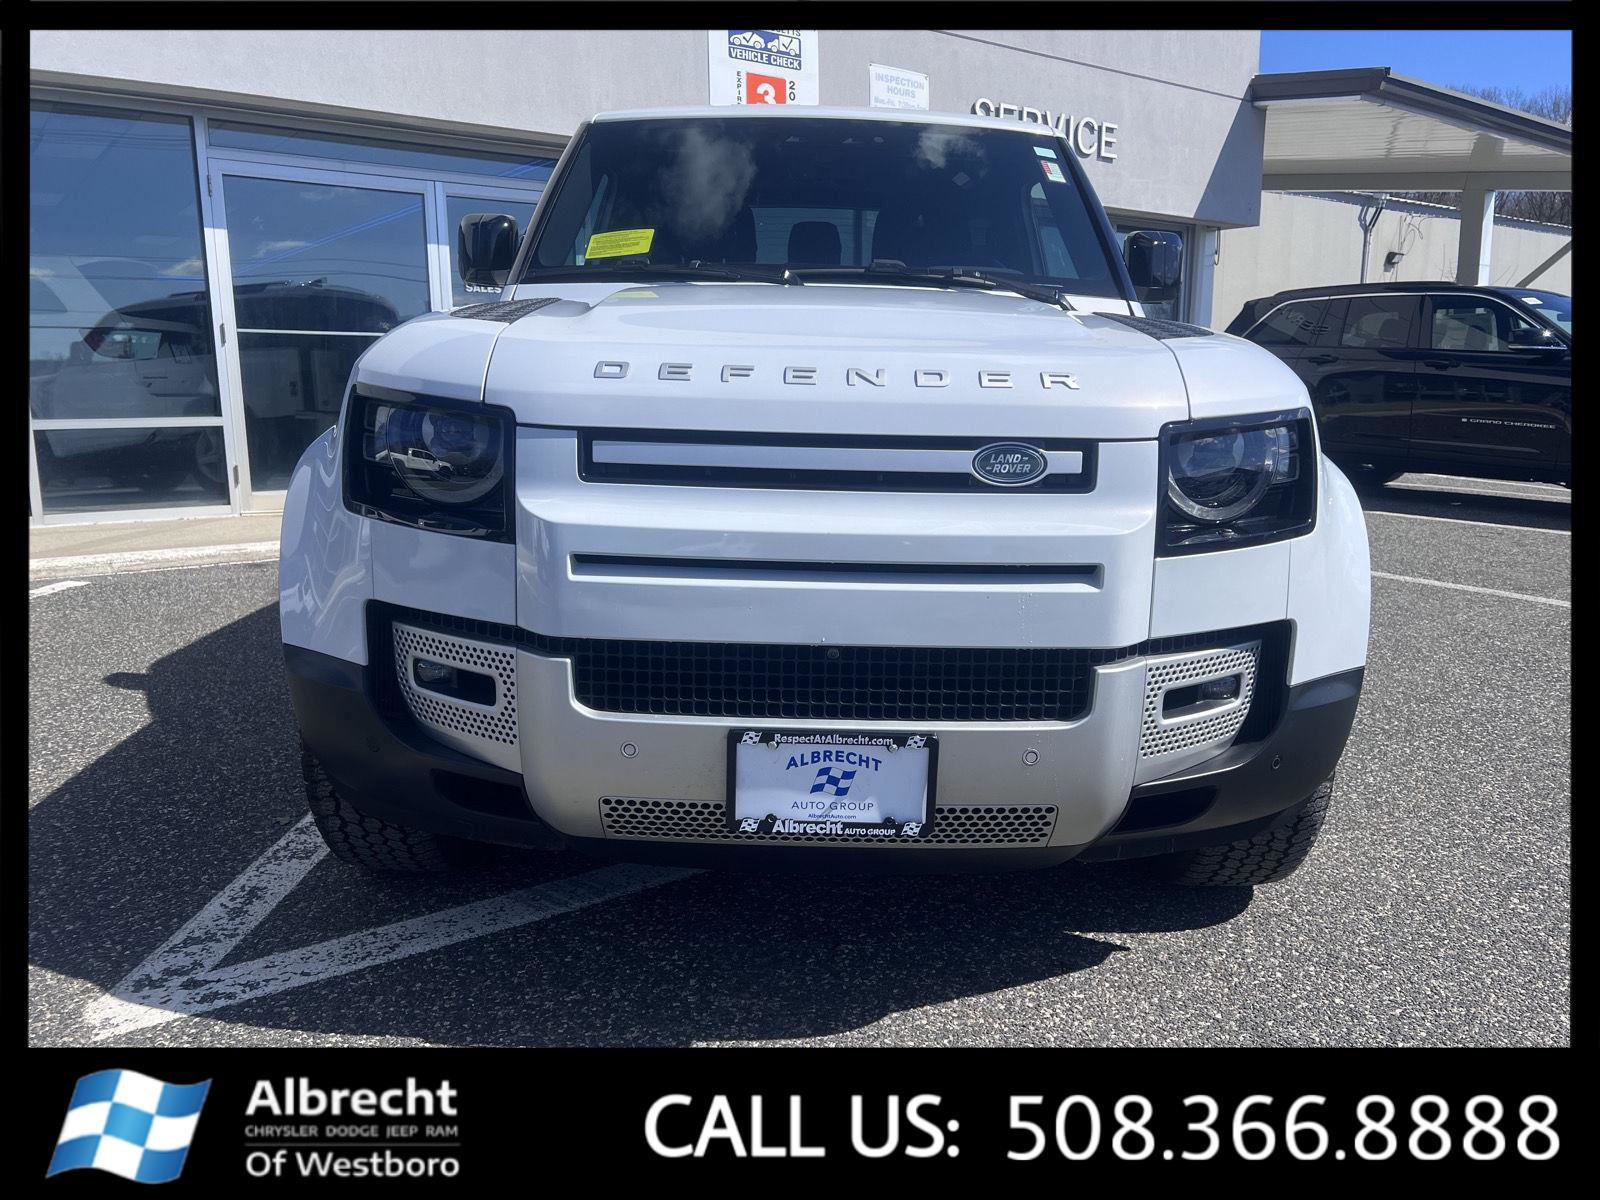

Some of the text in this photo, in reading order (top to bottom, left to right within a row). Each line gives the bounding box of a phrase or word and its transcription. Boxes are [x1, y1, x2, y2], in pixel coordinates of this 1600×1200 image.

[731, 47, 801, 70] VEHICLE CHECK
[875, 72, 925, 90] INSPECTION
[756, 82, 777, 104] 3
[887, 85, 916, 99] HOURS
[465, 285, 502, 293] SALES
[593, 360, 1080, 390] DEFENDER
[1504, 421, 1556, 429] CHEROKEE
[774, 733, 894, 746] RespectAtAlbrecht.com
[785, 749, 882, 772] ALBRECHT
[791, 801, 874, 811] AUTO GROUP
[807, 812, 857, 820] AlbrechtAuto.com
[772, 819, 896, 836] Albrecht AUTO GROUP
